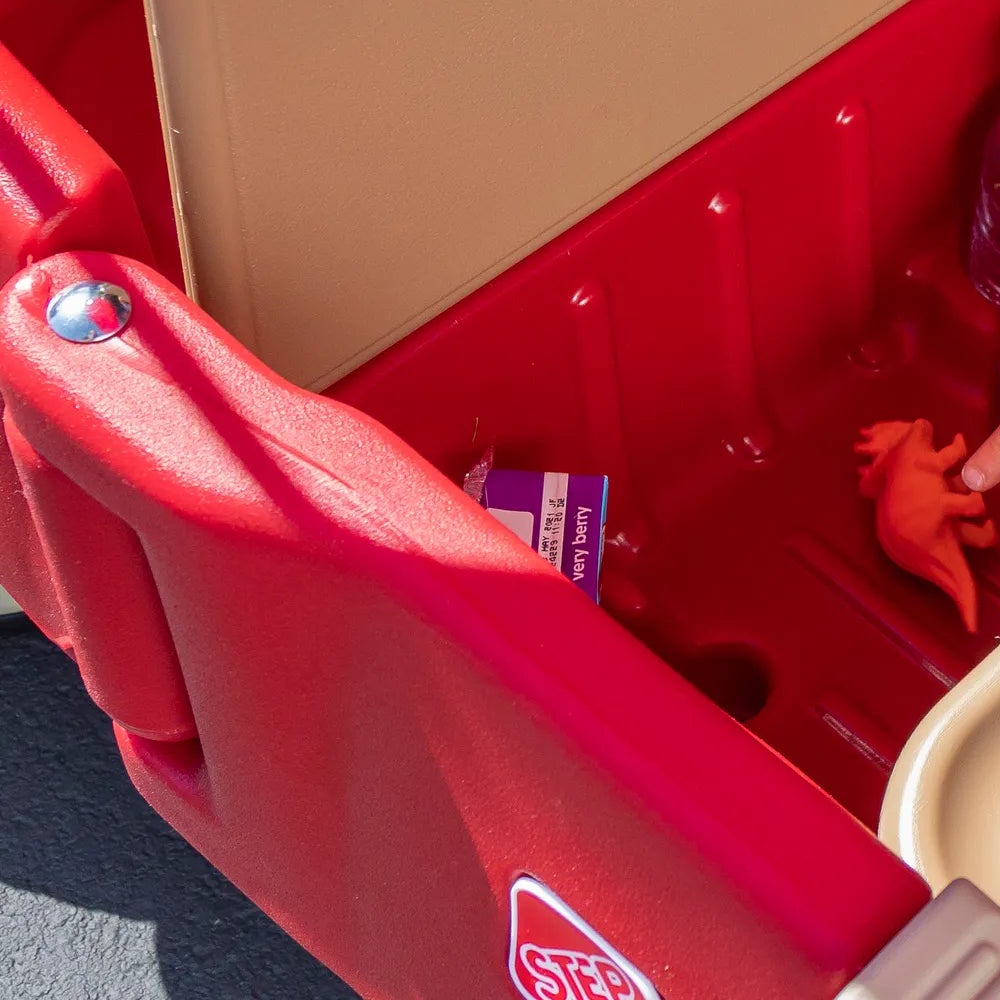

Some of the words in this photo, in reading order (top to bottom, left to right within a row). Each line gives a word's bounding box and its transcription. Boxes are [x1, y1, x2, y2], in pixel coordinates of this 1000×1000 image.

[544, 512, 554, 531] 2021
[552, 511, 563, 535] 11:20
[572, 506, 592, 545] berry
[571, 549, 589, 581] very
[522, 946, 634, 1000] STEP
